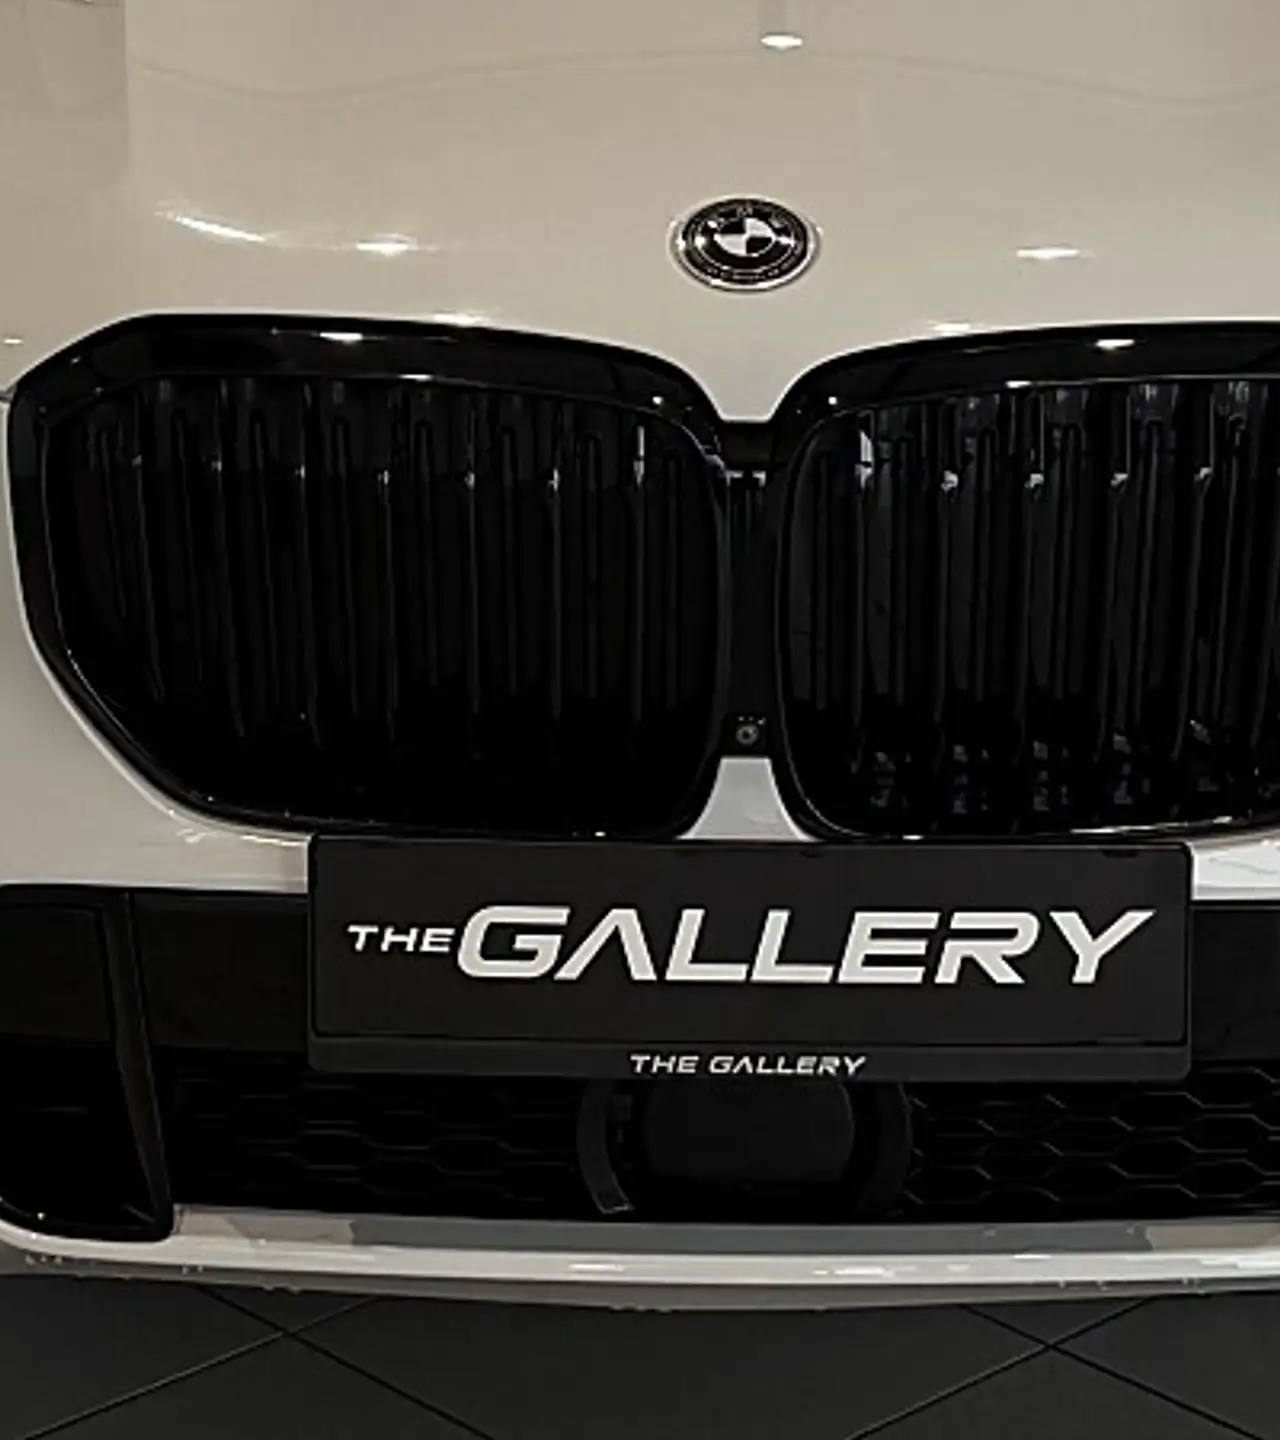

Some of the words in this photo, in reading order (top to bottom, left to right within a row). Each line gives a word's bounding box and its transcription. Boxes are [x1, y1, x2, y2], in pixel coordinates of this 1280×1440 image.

[347, 924, 455, 954] THE
[456, 905, 1155, 985] GALLERY
[629, 1054, 699, 1075] THE
[708, 1054, 867, 1076] GALLERY
